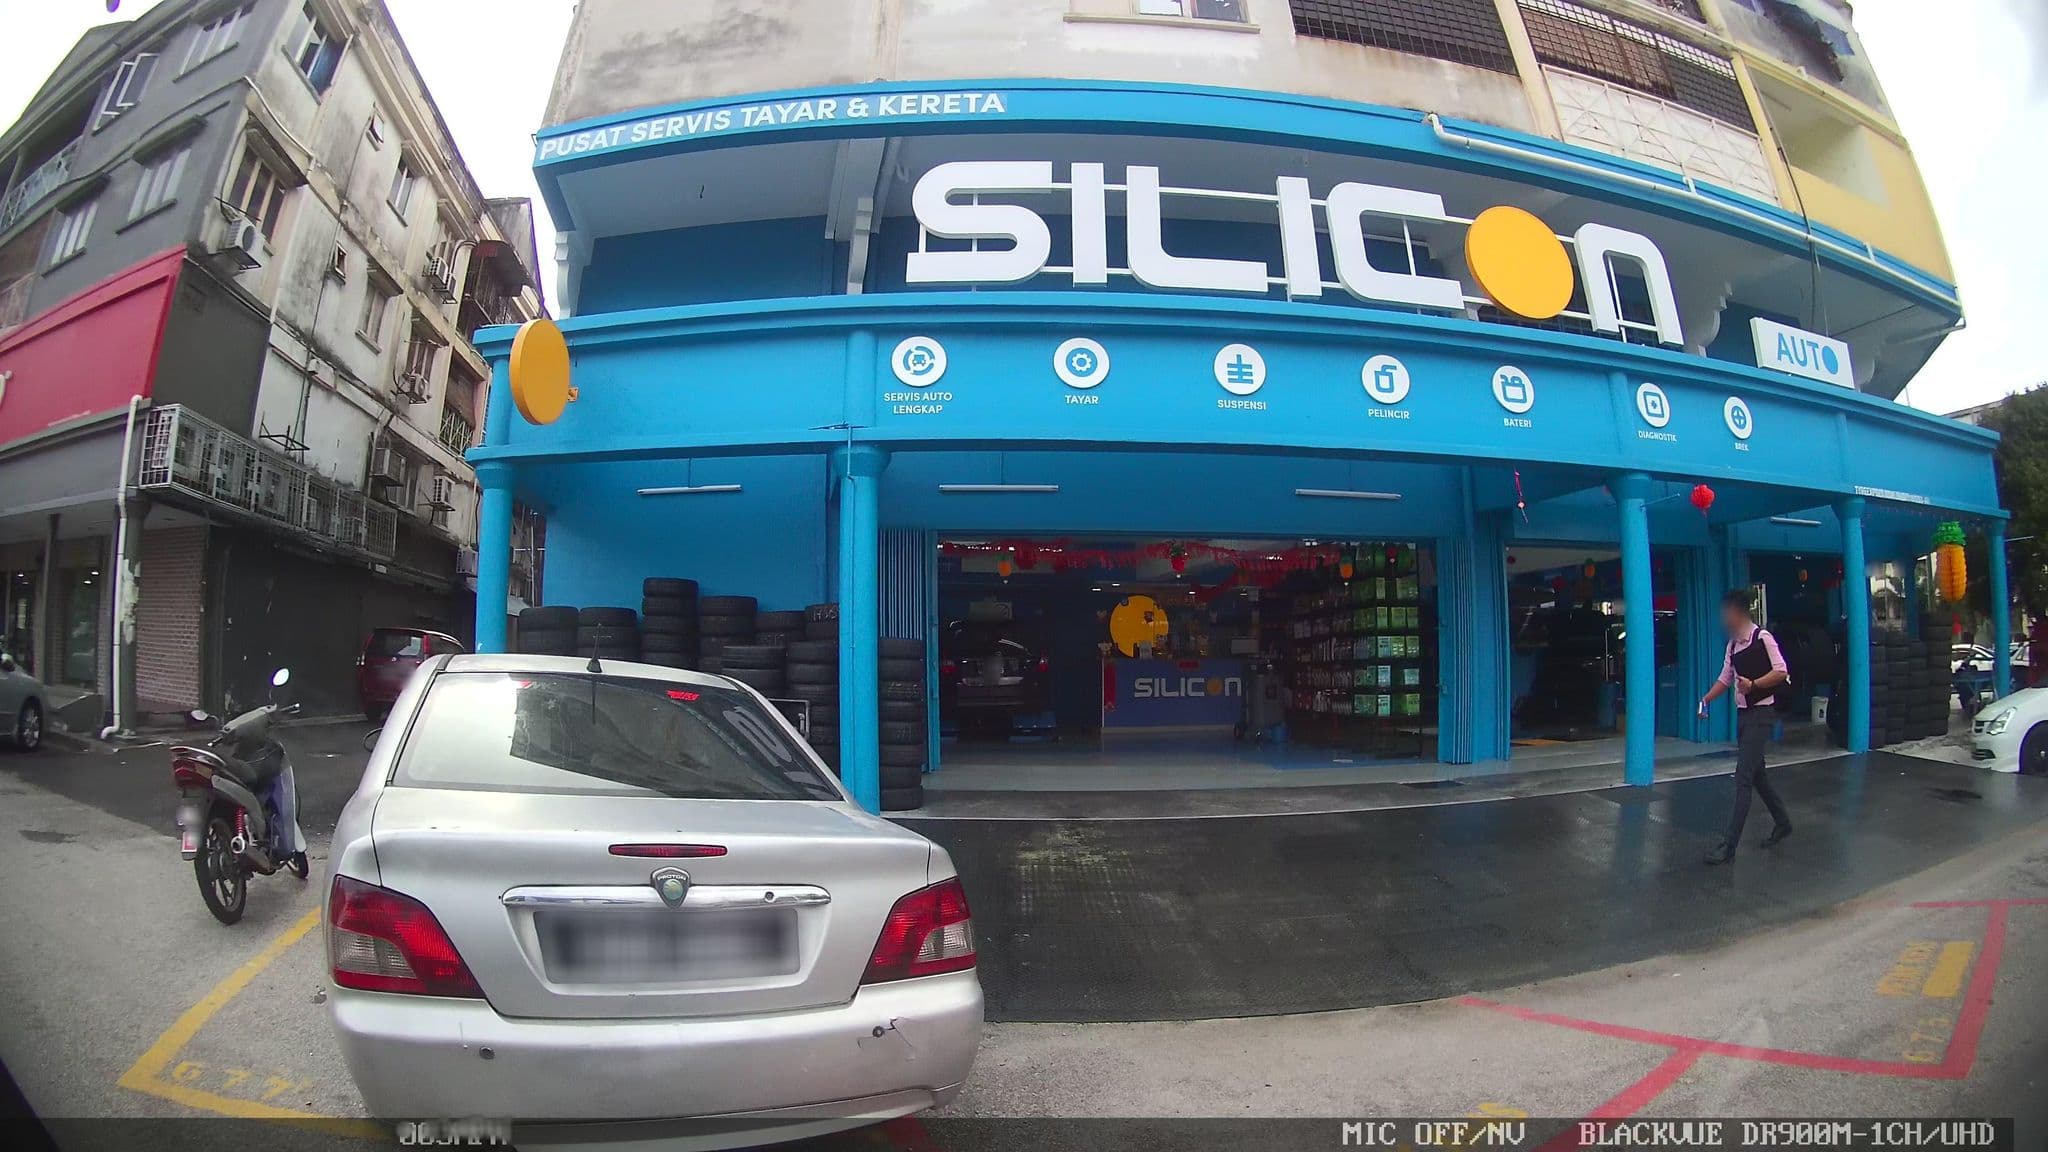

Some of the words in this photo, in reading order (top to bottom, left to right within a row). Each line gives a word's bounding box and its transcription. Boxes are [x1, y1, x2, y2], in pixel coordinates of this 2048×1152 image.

[540, 126, 626, 160] PUSAT
[631, 110, 731, 143] SERVIS
[740, 99, 838, 128] TAYAR
[846, 97, 869, 118] &
[878, 92, 1006, 117] KERETA
[1777, 332, 1839, 375] AUTO
[883, 392, 920, 402] SERVIS
[923, 392, 953, 401] AUTO
[1064, 394, 1099, 405] TAYAR
[893, 404, 943, 415] LENGKAP
[1217, 399, 1267, 411] SUSPENSI
[1367, 408, 1410, 420] PELINCIR
[1503, 417, 1532, 429] BATERI
[1637, 430, 1677, 442] DIAGNOSTIK
